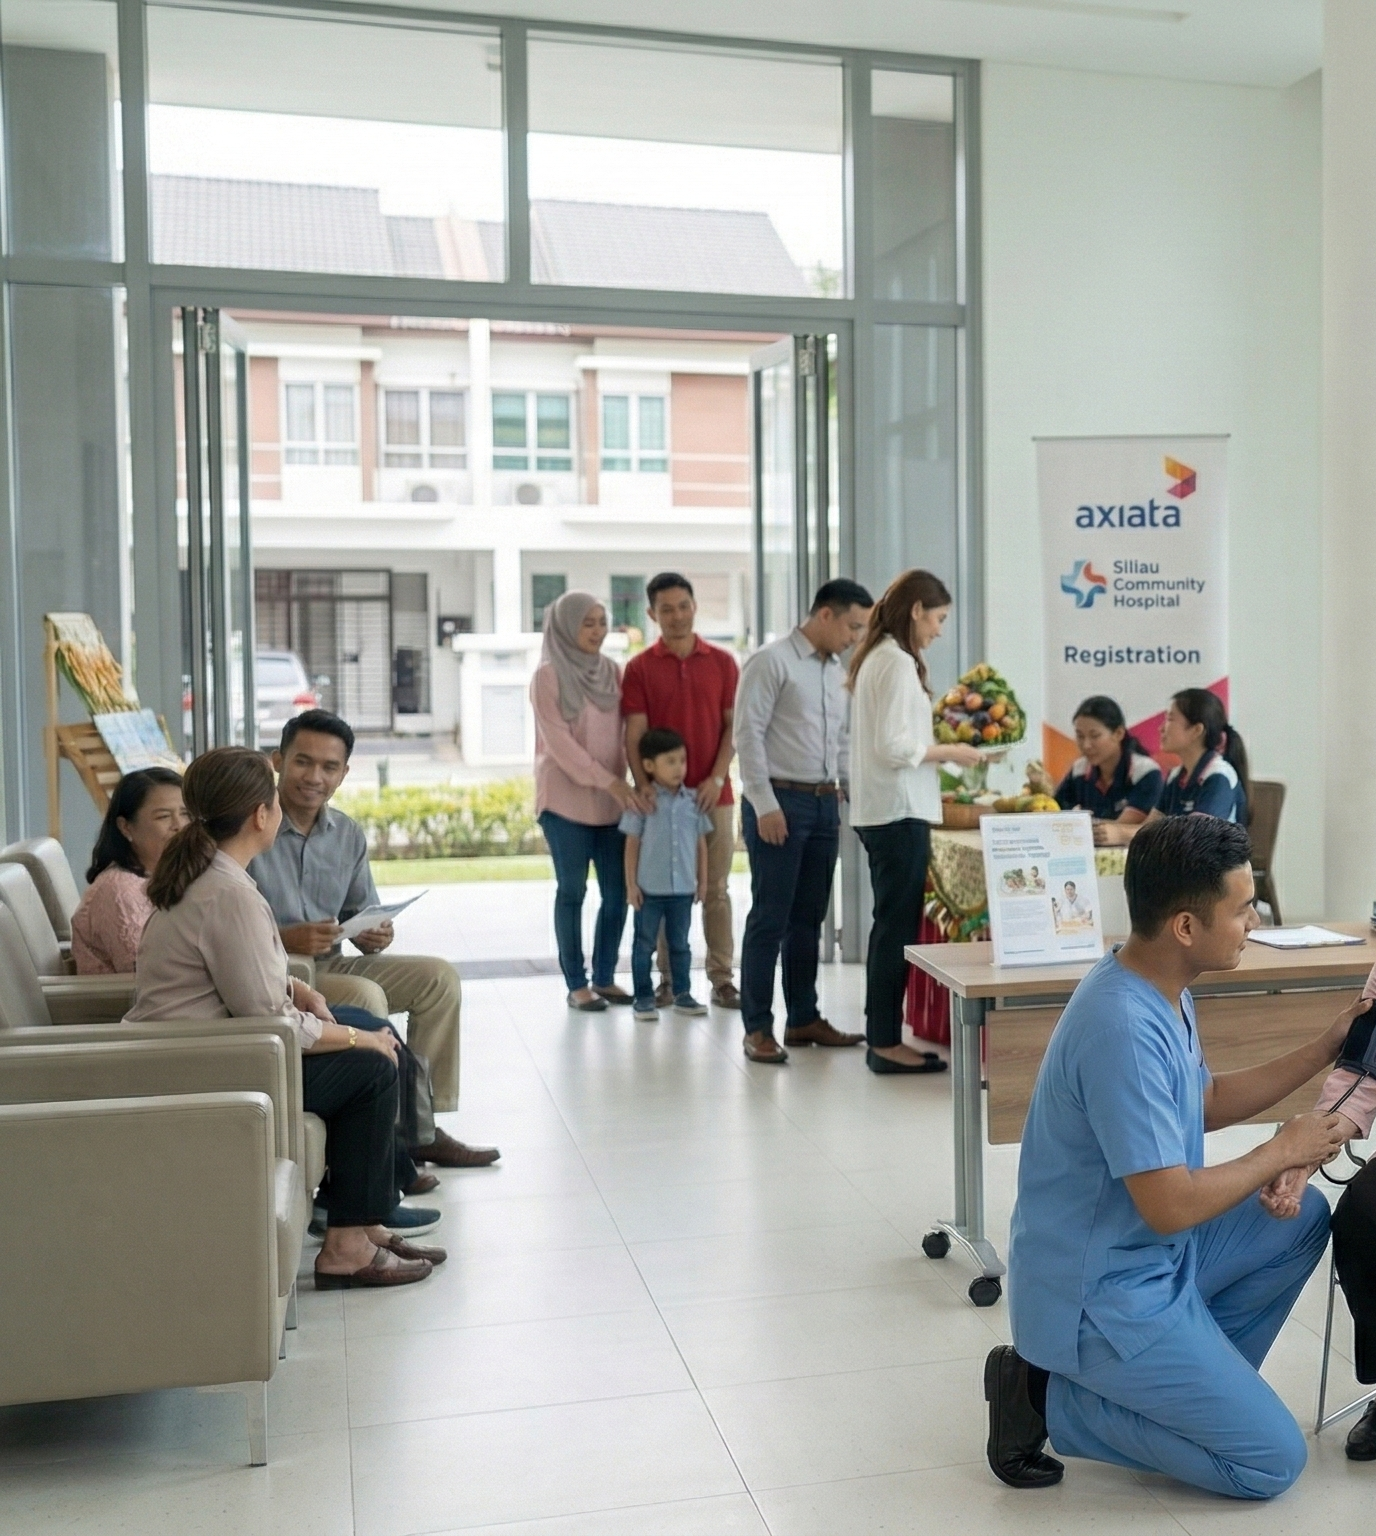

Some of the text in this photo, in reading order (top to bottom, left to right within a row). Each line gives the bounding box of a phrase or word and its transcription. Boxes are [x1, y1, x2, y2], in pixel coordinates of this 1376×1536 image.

[1075, 498, 1181, 529] axiata
[1113, 560, 1160, 575] Siliau
[1113, 577, 1206, 594] Community
[1113, 594, 1180, 610] Hospital
[1064, 646, 1201, 668] Registration
